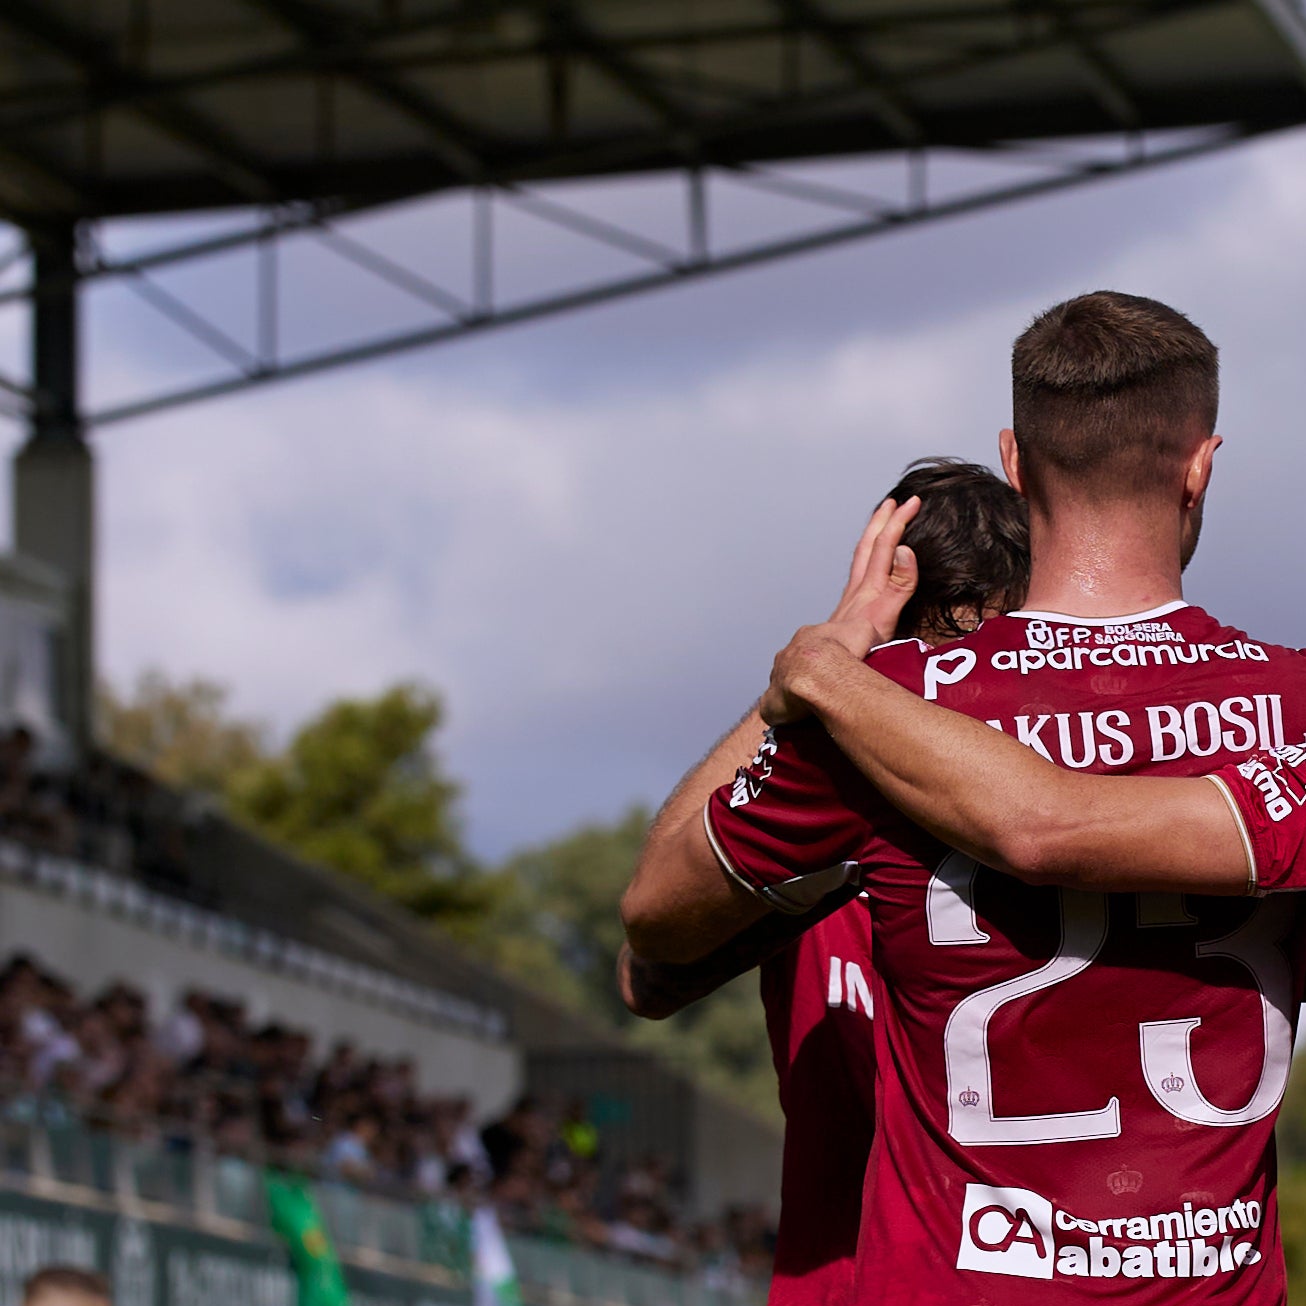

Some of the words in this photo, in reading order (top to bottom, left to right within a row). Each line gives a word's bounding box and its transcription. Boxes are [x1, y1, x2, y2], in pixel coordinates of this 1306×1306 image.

[990, 639, 1270, 675] aparcamurcia
[985, 708, 1131, 769] KUS
[926, 851, 1293, 1147] 23
